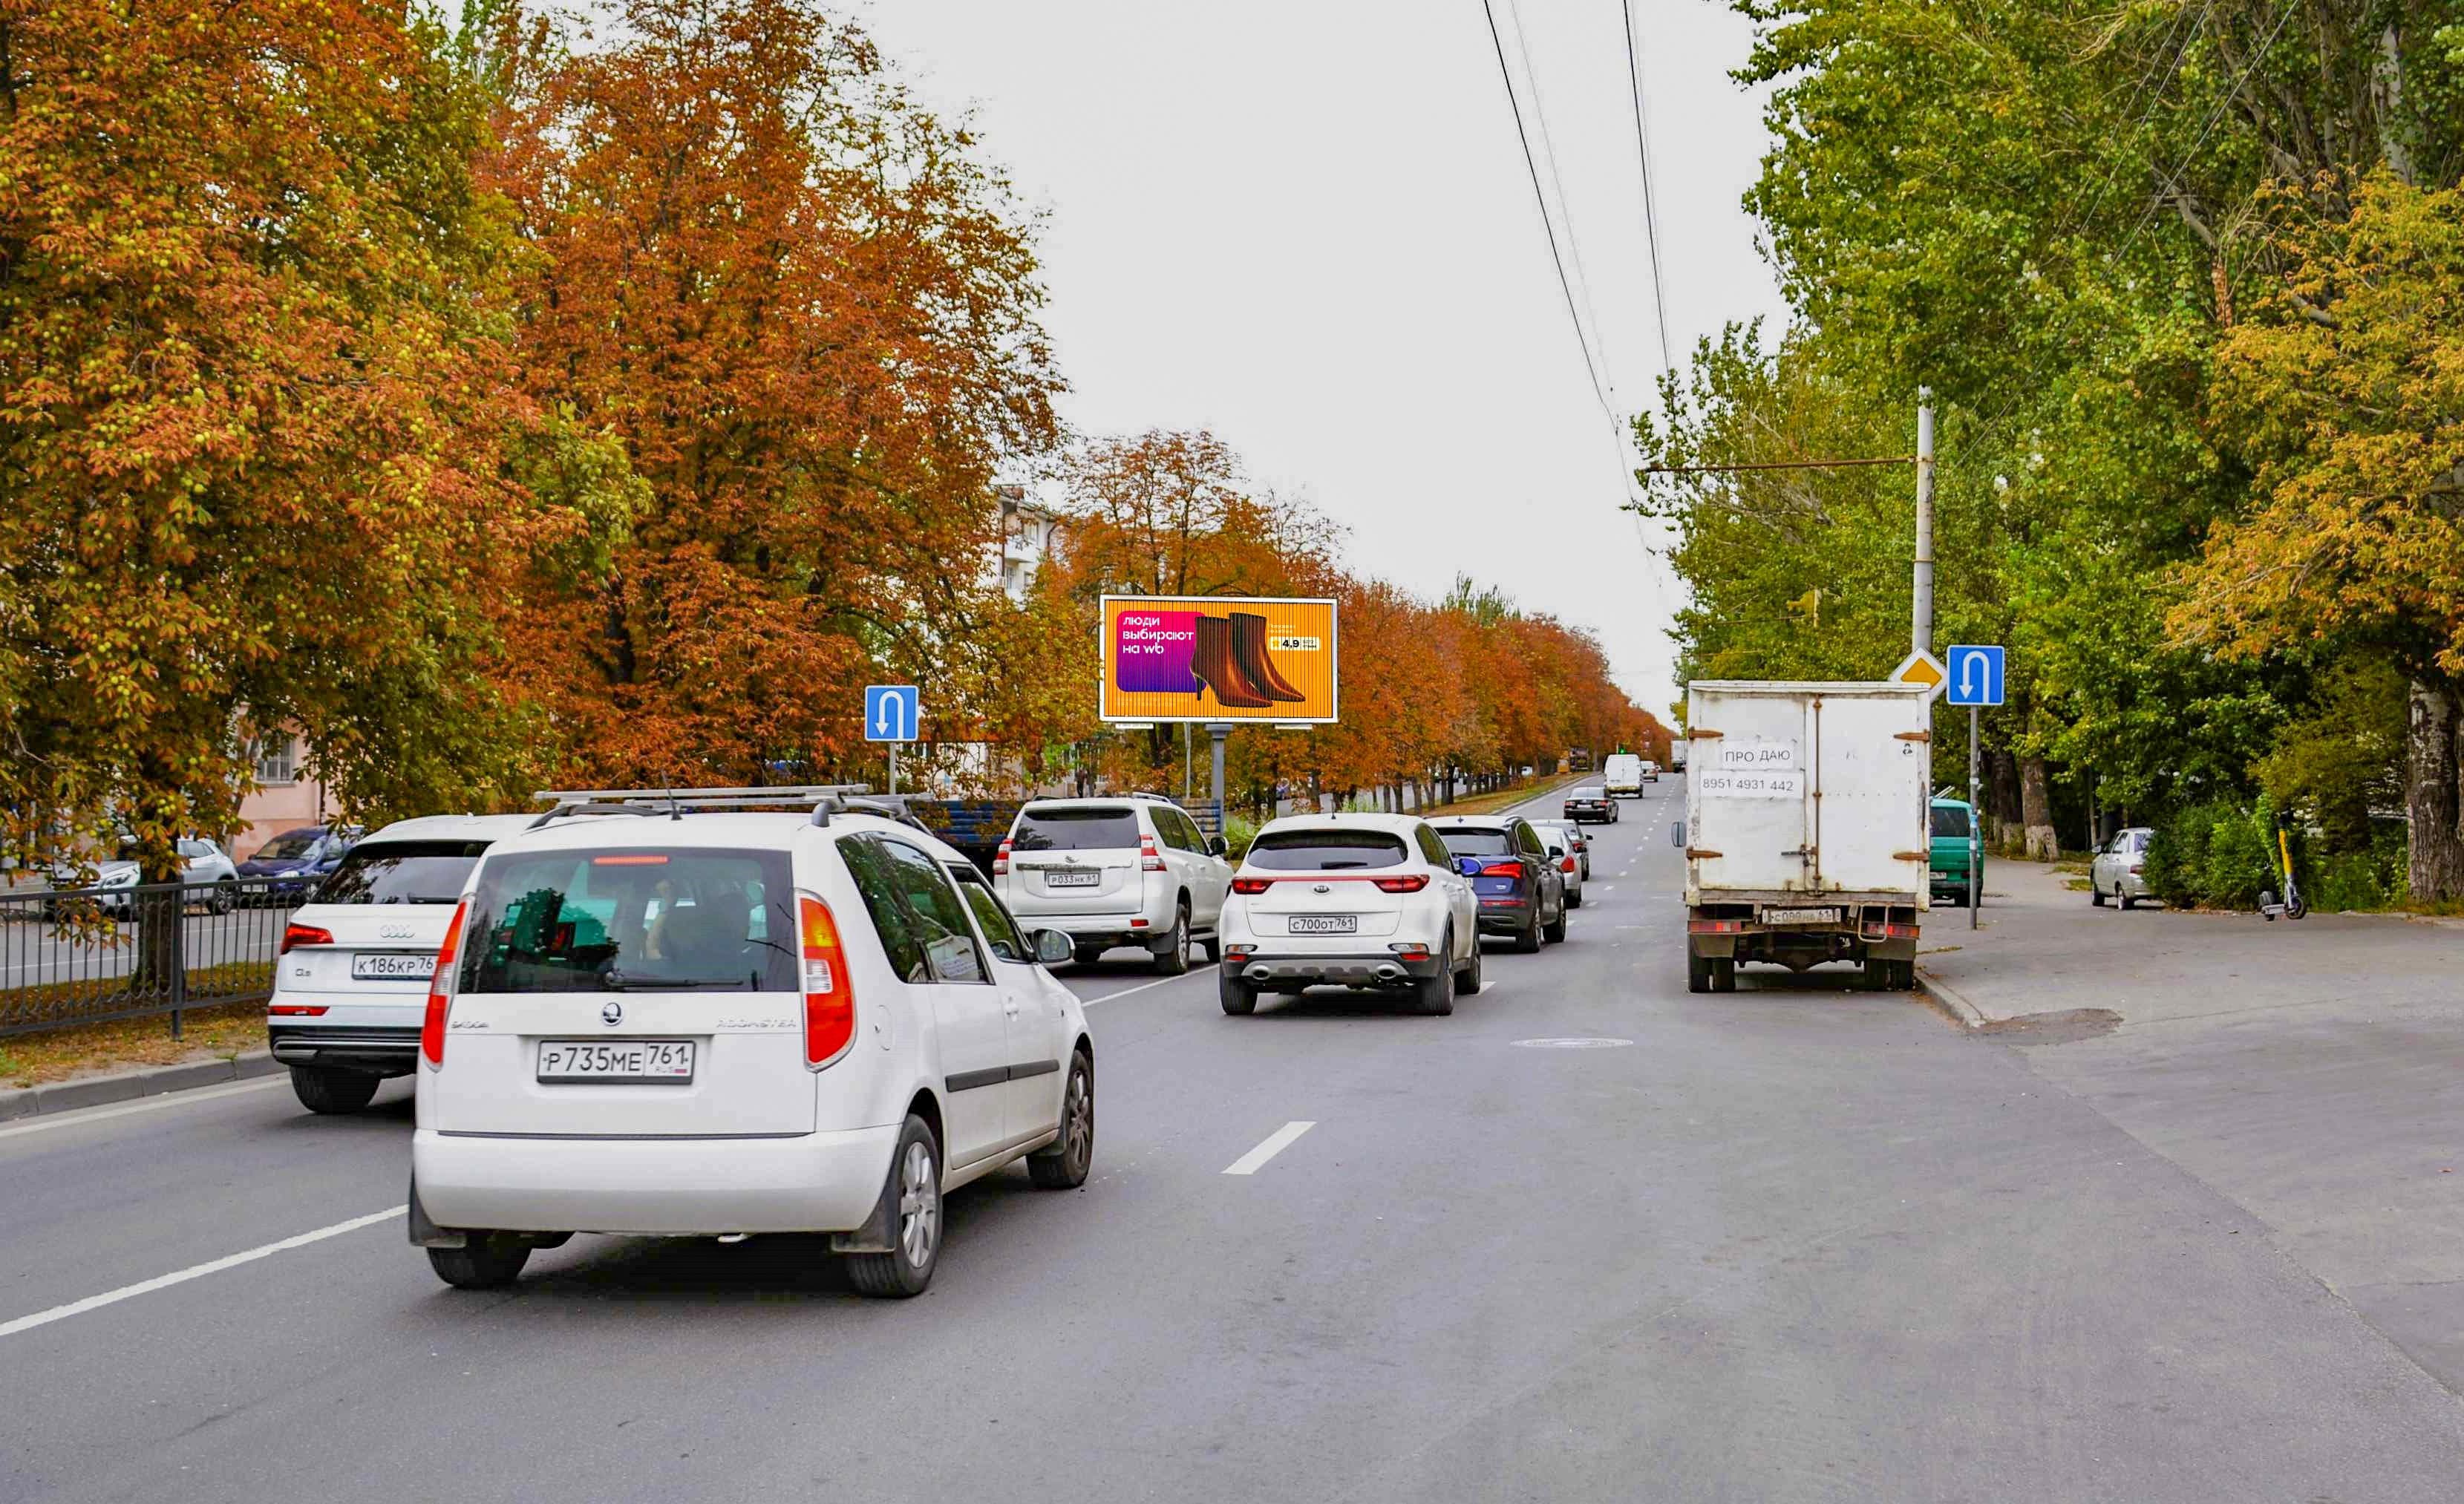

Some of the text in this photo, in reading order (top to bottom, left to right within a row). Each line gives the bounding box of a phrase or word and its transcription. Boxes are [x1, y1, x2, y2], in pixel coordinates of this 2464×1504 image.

[1123, 616, 1160, 628] люди
[1122, 628, 1195, 643] выбирают
[1122, 641, 1165, 655] на wb
[1282, 639, 1300, 650] 4,9
[1725, 749, 1791, 763] ПРО ДАЮ
[1702, 777, 1794, 792] 8951 4931 442
[358, 957, 416, 974] К186КР
[546, 1045, 685, 1072] Р735МЕ 761
